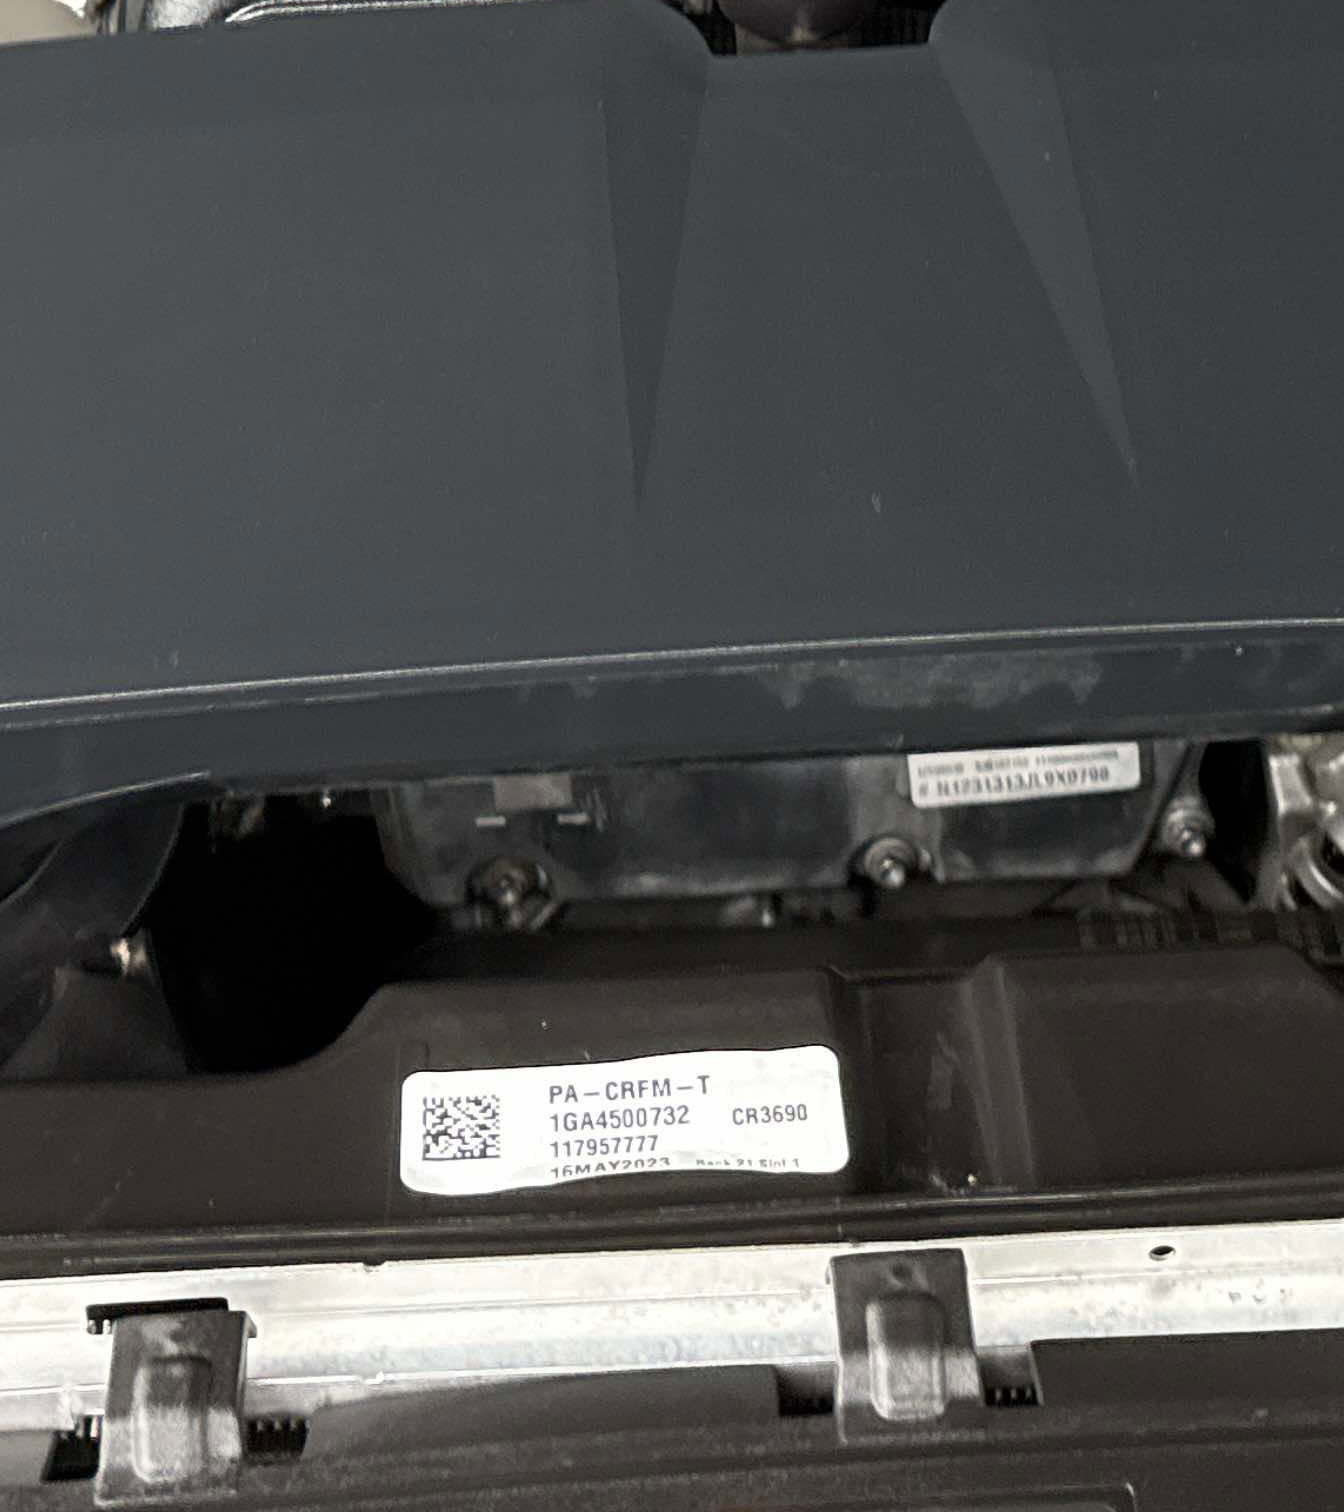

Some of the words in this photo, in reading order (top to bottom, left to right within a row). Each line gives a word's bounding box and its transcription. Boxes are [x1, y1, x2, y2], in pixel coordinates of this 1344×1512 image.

[550, 1105, 690, 1133] 1GA4500732
[732, 1104, 808, 1127] CR3690
[550, 1135, 659, 1158] 117957777
